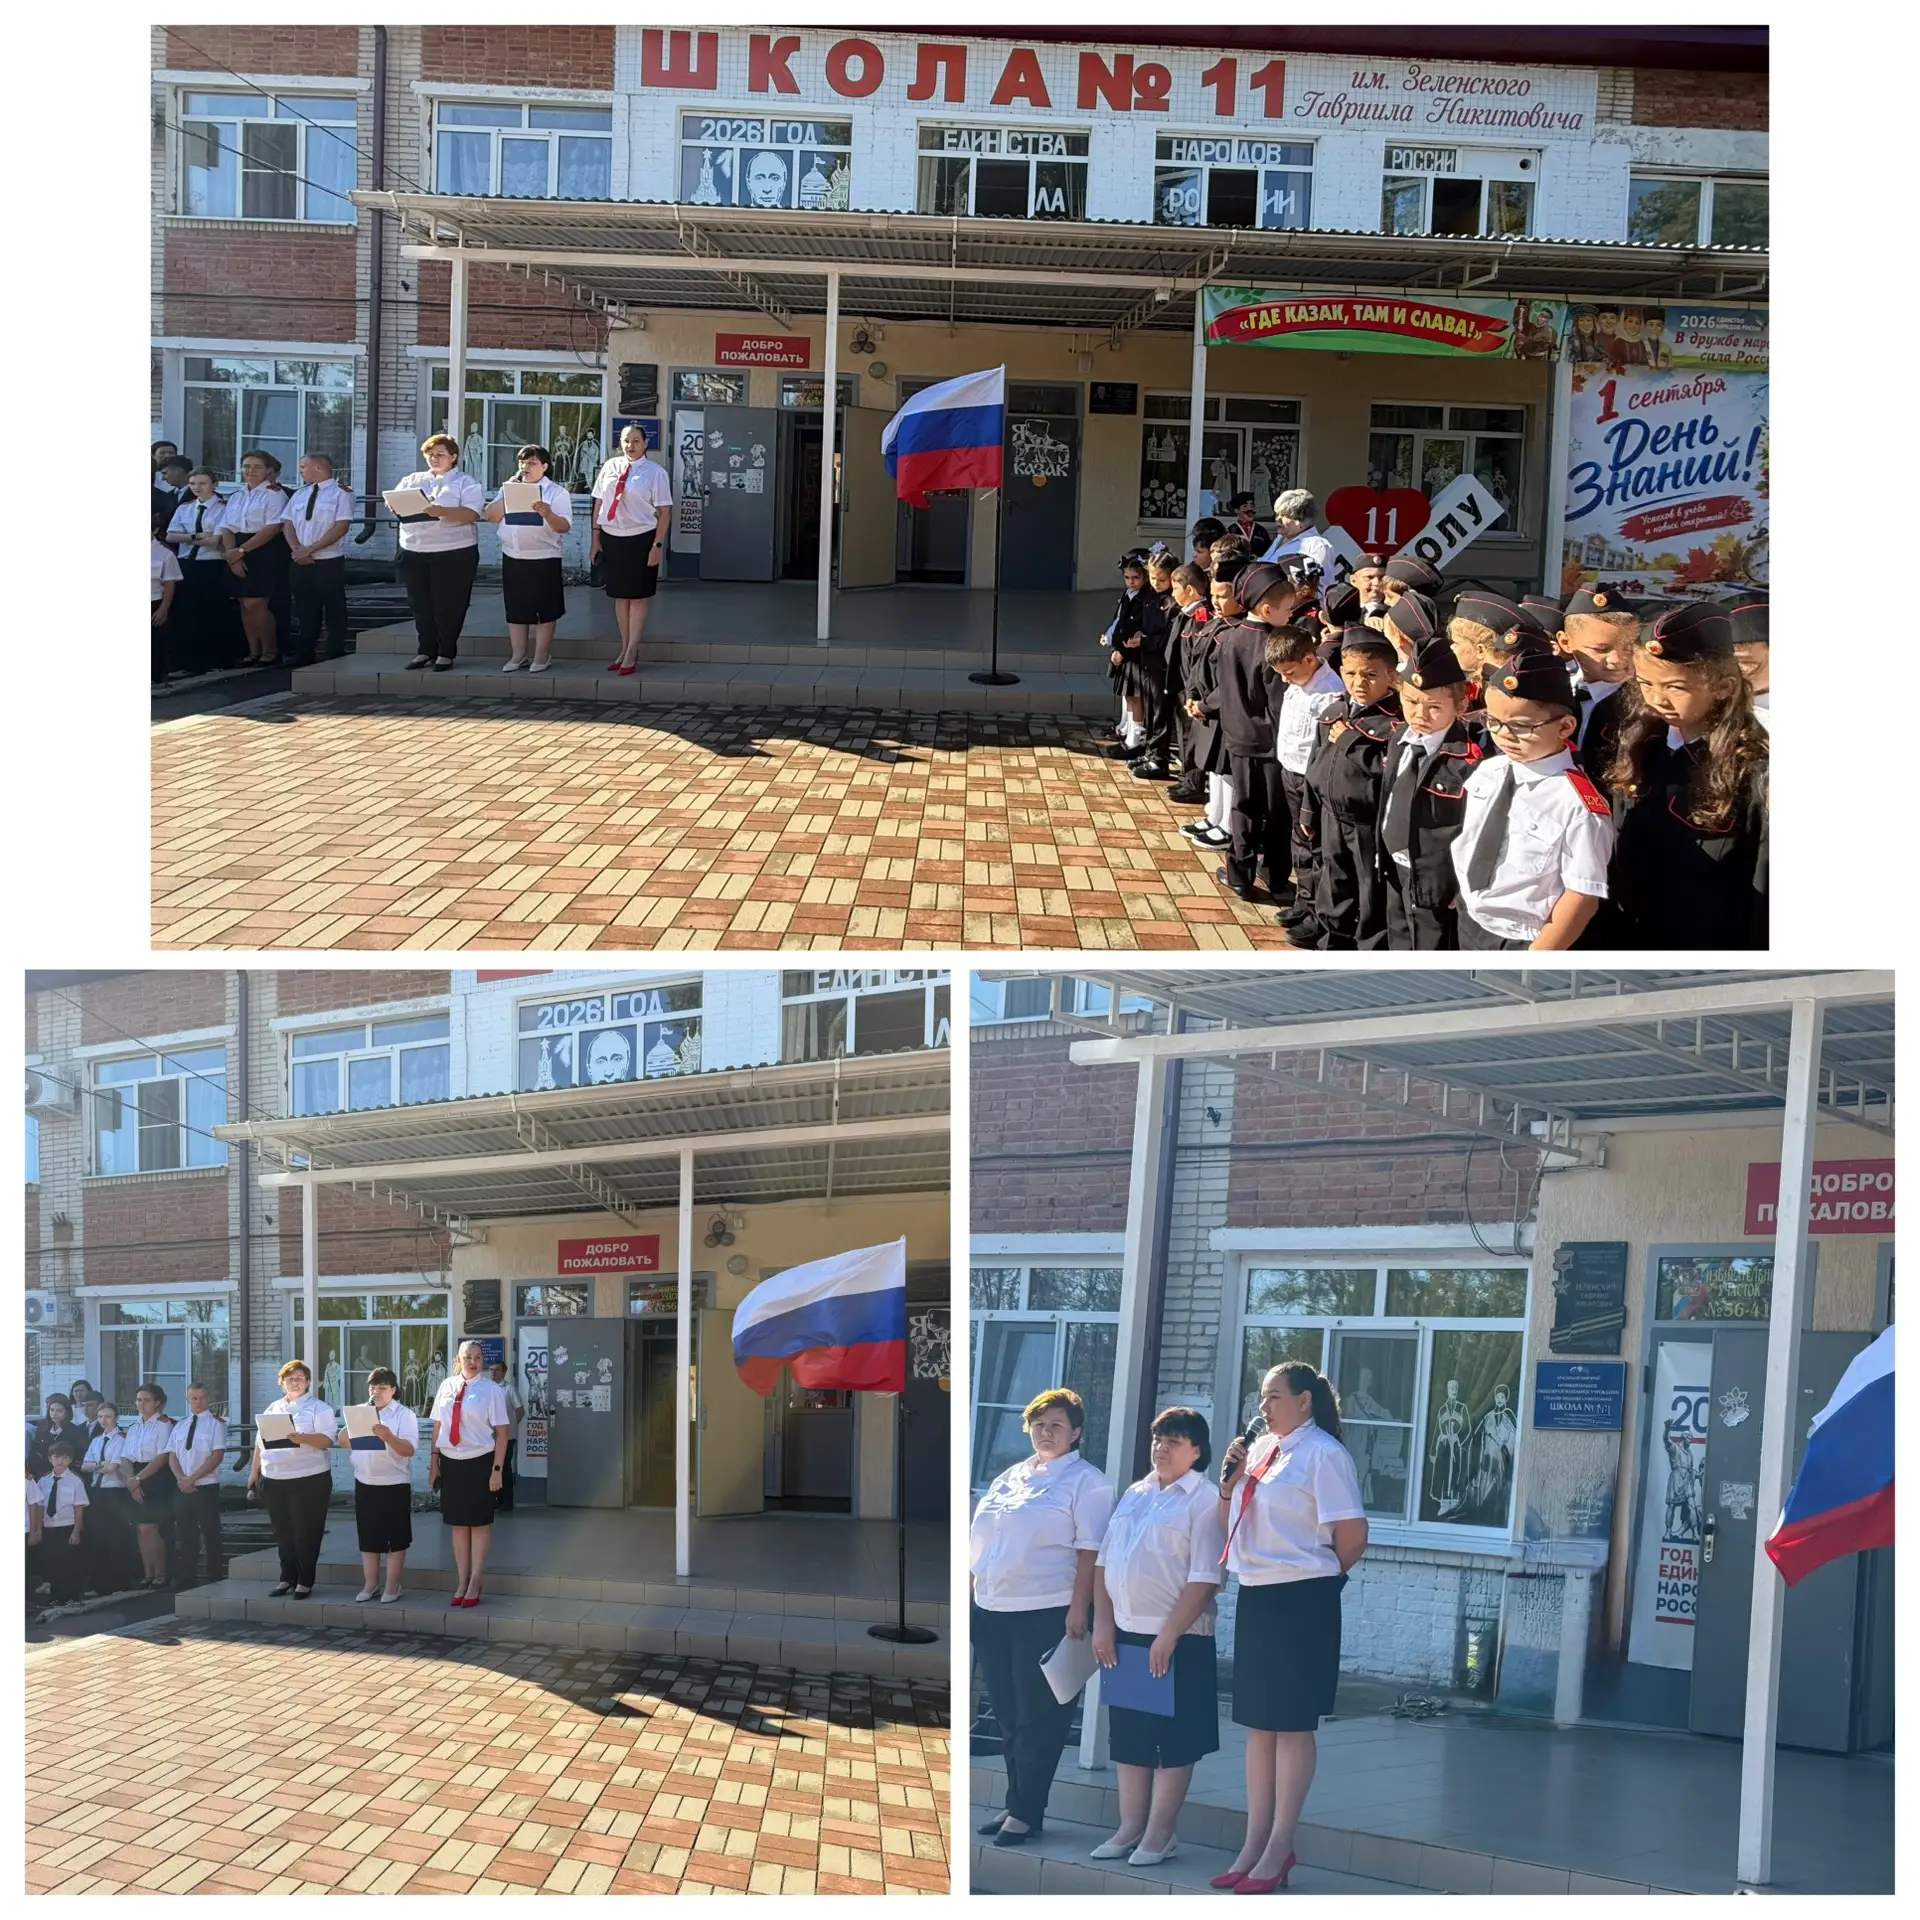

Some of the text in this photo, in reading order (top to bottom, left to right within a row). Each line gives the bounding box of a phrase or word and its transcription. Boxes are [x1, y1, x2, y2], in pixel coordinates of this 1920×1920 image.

[641, 29, 1286, 118] ШКОЛА № 11
[1352, 65, 1531, 97] им. Зеленского
[1294, 91, 1584, 131] Гавриила Никитовича
[701, 119, 818, 144] 2026 ГОД
[944, 129, 1067, 156] ЕДИНСТВА
[1171, 139, 1282, 165] НАРОДОВ
[1392, 150, 1456, 172] РОССИИ
[1240, 304, 1483, 340] «ГДЕ КАЗАК, ТАМ И СЛАВА!»
[1680, 315, 1715, 329] 2026
[742, 340, 783, 350] ДОБРО
[1674, 331, 1685, 344] В
[1690, 331, 1740, 349] дружбе
[721, 351, 804, 363] ПОЖАЛОВАТЬ
[1700, 351, 1732, 364] сила
[1596, 373, 1727, 424] 1 сентября
[1604, 414, 1718, 471] День
[1565, 426, 1762, 522] Знаний!
[1364, 507, 1398, 545] 11
[1404, 493, 1482, 564] ОЛУ
[538, 990, 664, 1029] 2026 ГОД
[1757, 1201, 1895, 1222] ПАЛОВ
[564, 1255, 652, 1269] ПОЖАЛОВАТЬ
[586, 1243, 629, 1256] ДОБРО
[1550, 1402, 1582, 1411] ШКОЛА
[1671, 1395, 1708, 1433] 20
[527, 1422, 544, 1430] ГОД
[1661, 1547, 1693, 1565] ГОД
